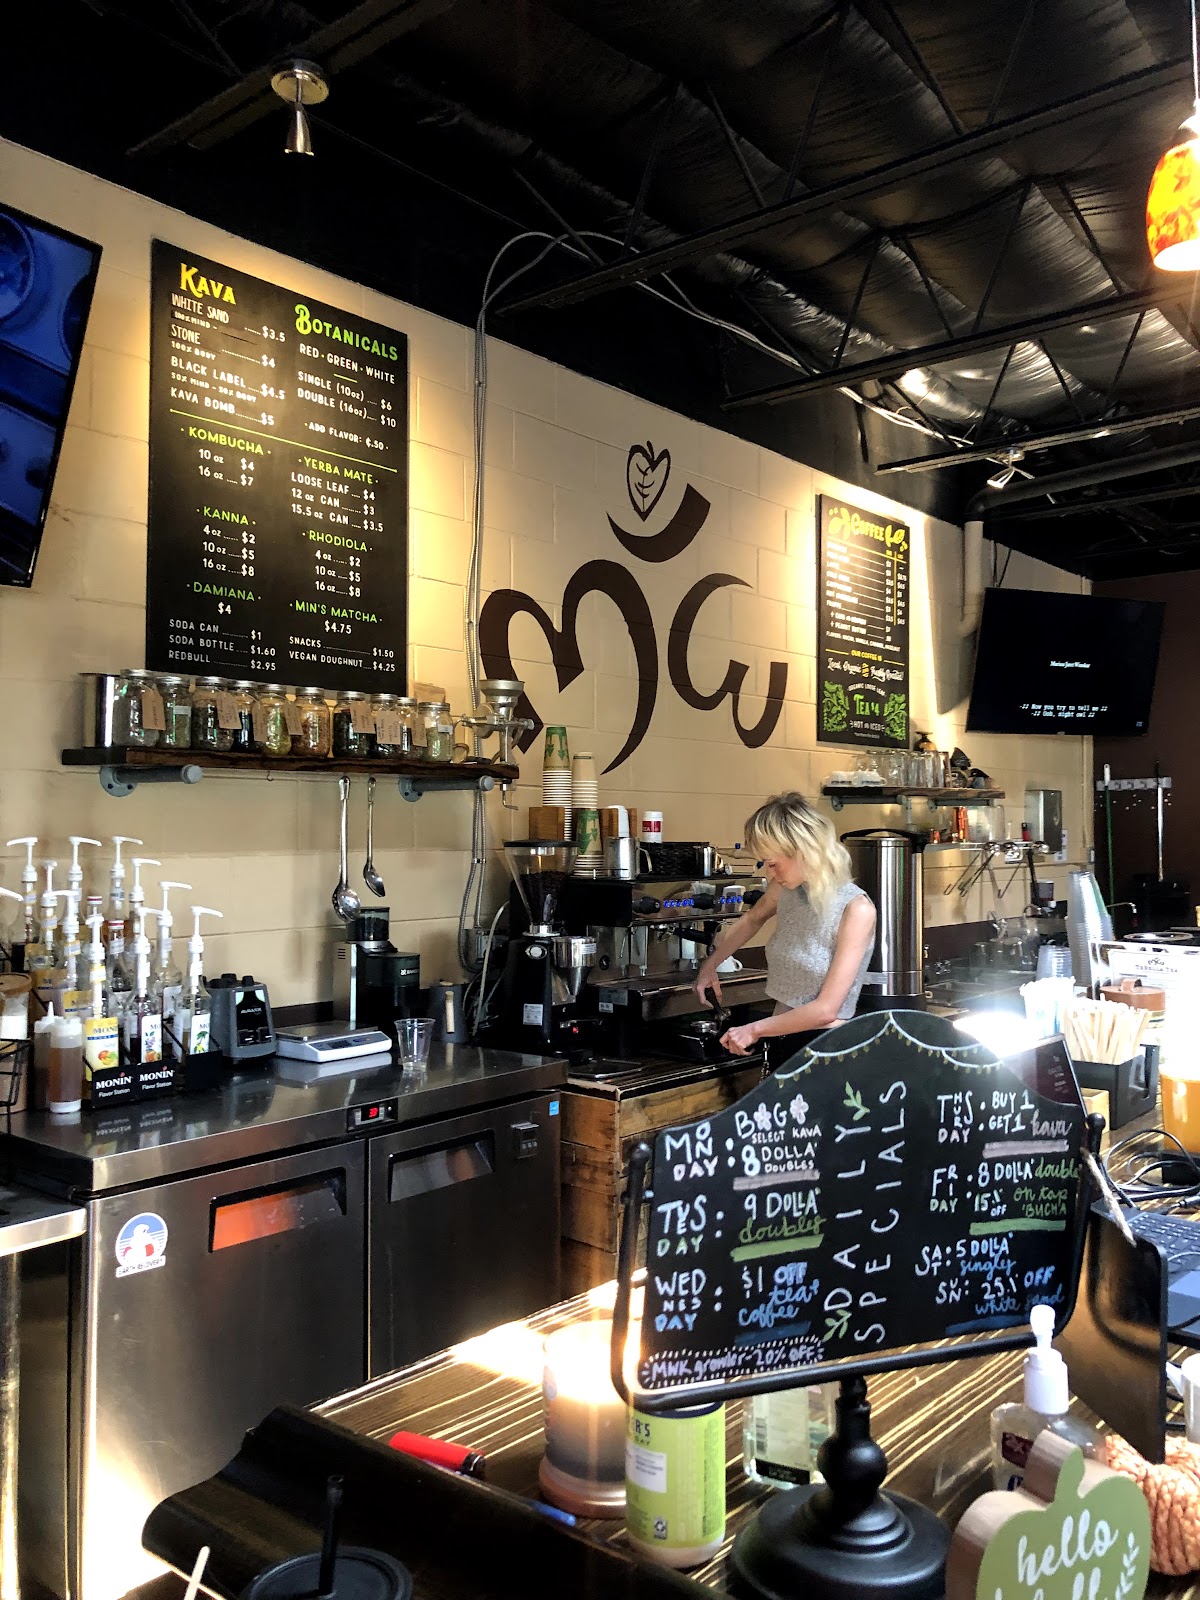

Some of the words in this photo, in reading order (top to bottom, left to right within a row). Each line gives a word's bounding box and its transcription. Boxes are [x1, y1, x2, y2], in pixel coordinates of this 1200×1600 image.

[180, 263, 236, 305] KAVA
[172, 293, 204, 316] WHITE
[207, 304, 230, 324] SAND
[262, 325, 286, 342] $3.5
[294, 304, 398, 360] BOTANICALS
[171, 324, 201, 345] STONE
[262, 354, 276, 369] $4
[171, 340, 192, 354] 100%
[300, 344, 320, 358] RED
[327, 353, 358, 372] GREEN
[366, 366, 395, 384] WHITE
[171, 356, 208, 376] BLACK
[213, 369, 246, 388] LABEL
[260, 384, 286, 400] $4.5
[298, 371, 332, 390] SINGLE
[380, 399, 392, 411] $6
[170, 387, 198, 404] KAVA
[204, 396, 236, 414] BOMB
[261, 412, 274, 426] $5
[298, 388, 336, 408] DOUBLE
[380, 415, 396, 428] $10
[189, 426, 264, 456] KOMBUCHA
[199, 449, 212, 460] 10
[214, 454, 224, 464] oz
[240, 458, 254, 471] $4
[304, 456, 340, 476] YERBA
[344, 468, 373, 484] MATE
[199, 466, 211, 476] 16
[214, 471, 224, 480] oz
[240, 474, 254, 486] $7
[291, 472, 322, 488] LOOSE
[326, 481, 350, 494] LEAF
[364, 489, 375, 500] $4
[292, 488, 302, 498] 12
[320, 495, 340, 508] CAN
[364, 504, 374, 516] $3
[204, 506, 249, 526] KANNA
[292, 504, 312, 516] 15.5
[330, 512, 349, 524] CAN
[364, 520, 384, 532] $3.5
[203, 525, 210, 536] 4
[212, 529, 222, 537] oz
[242, 531, 256, 544] $2
[310, 530, 368, 552] RHODIOLA
[203, 542, 215, 553] 10
[216, 547, 226, 555] oz
[242, 547, 255, 560] $5
[315, 550, 322, 560] 4
[350, 556, 360, 567] $2
[203, 558, 214, 568] 16
[242, 563, 254, 576] $8
[315, 565, 326, 576] 10
[349, 570, 360, 582] $5
[194, 582, 254, 602] DAMIANA
[315, 581, 326, 591] 16
[349, 586, 360, 598] $8
[218, 602, 232, 614] $4
[296, 600, 326, 614] MIN'S
[331, 606, 378, 624] MATCHA
[170, 618, 194, 630] SODA
[200, 623, 219, 633] CAN
[251, 630, 262, 640] $1
[325, 620, 352, 634] $4.75
[169, 634, 194, 646] SODA
[200, 638, 234, 652] BOTTLE
[250, 644, 276, 656] $1.60
[290, 636, 321, 648] SNACKS
[372, 648, 394, 658] $1.50
[168, 650, 210, 662] REDBULL
[250, 660, 276, 671] $2.95
[289, 651, 317, 662] VEGAN
[320, 654, 362, 668] DOUGHNUT
[372, 661, 396, 672] $4.25
[96, 1076, 132, 1090] MONIN
[140, 1070, 174, 1082] MONIN
[992, 1091, 1016, 1113] BUY
[1020, 1090, 1035, 1110] 1
[752, 1130, 786, 1144] SELECT
[792, 1124, 822, 1138] KAVA
[988, 1114, 1012, 1134] GET
[1011, 1113, 1026, 1132] 1
[1030, 1109, 1072, 1138] kava
[938, 1128, 970, 1144] DAY
[673, 1156, 718, 1181] DAY
[742, 1144, 761, 1176] 8
[764, 1160, 814, 1172] DOUBLES
[978, 1162, 990, 1188] 8
[930, 1198, 958, 1214] DAY
[1014, 1186, 1036, 1201] on
[1038, 1185, 1068, 1206] tap
[744, 1194, 758, 1220] 9
[854, 1080, 907, 1344] SPECIALS
[990, 1204, 1008, 1216] OFF
[656, 1234, 704, 1257] DAY
[956, 1239, 967, 1258] 5
[654, 1268, 707, 1296] WED
[742, 1265, 763, 1298] $1
[774, 1261, 808, 1286] OFF
[1024, 1265, 1056, 1288] OFF
[654, 1312, 698, 1332] DAY
[738, 1303, 800, 1328] coffee
[1018, 1508, 1119, 1586] hello
